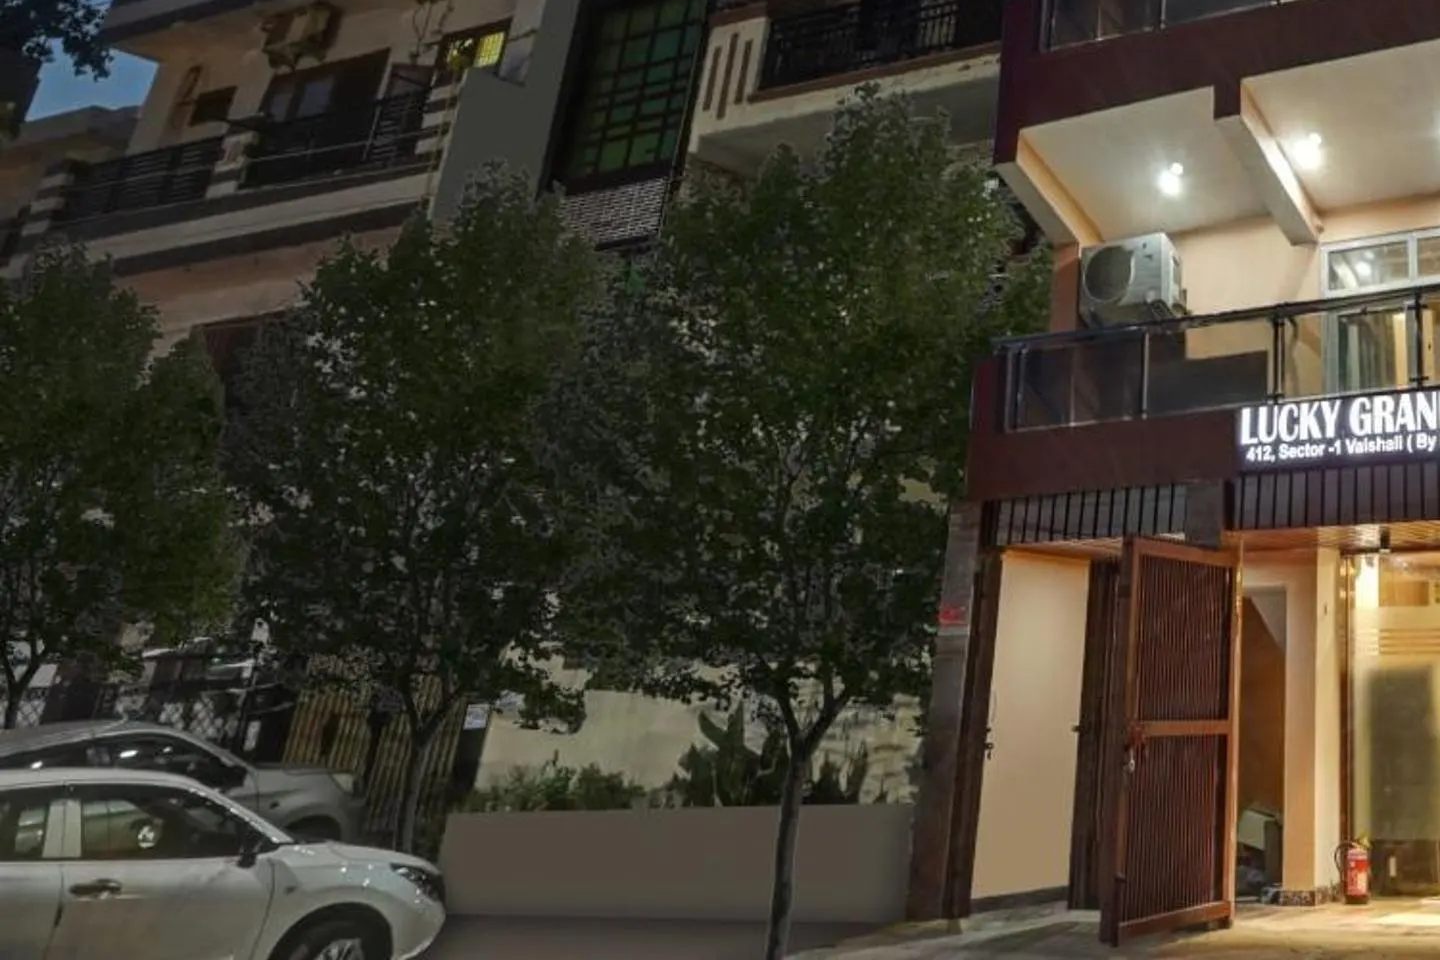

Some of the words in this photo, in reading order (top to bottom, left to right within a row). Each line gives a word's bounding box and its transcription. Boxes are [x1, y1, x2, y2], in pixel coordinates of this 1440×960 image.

[1240, 400, 1340, 444] LUCKY
[1246, 445, 1275, 462] 412,
[1278, 442, 1325, 460] Sector
[1345, 434, 1403, 454] Vaishali
[1416, 431, 1437, 452] By
